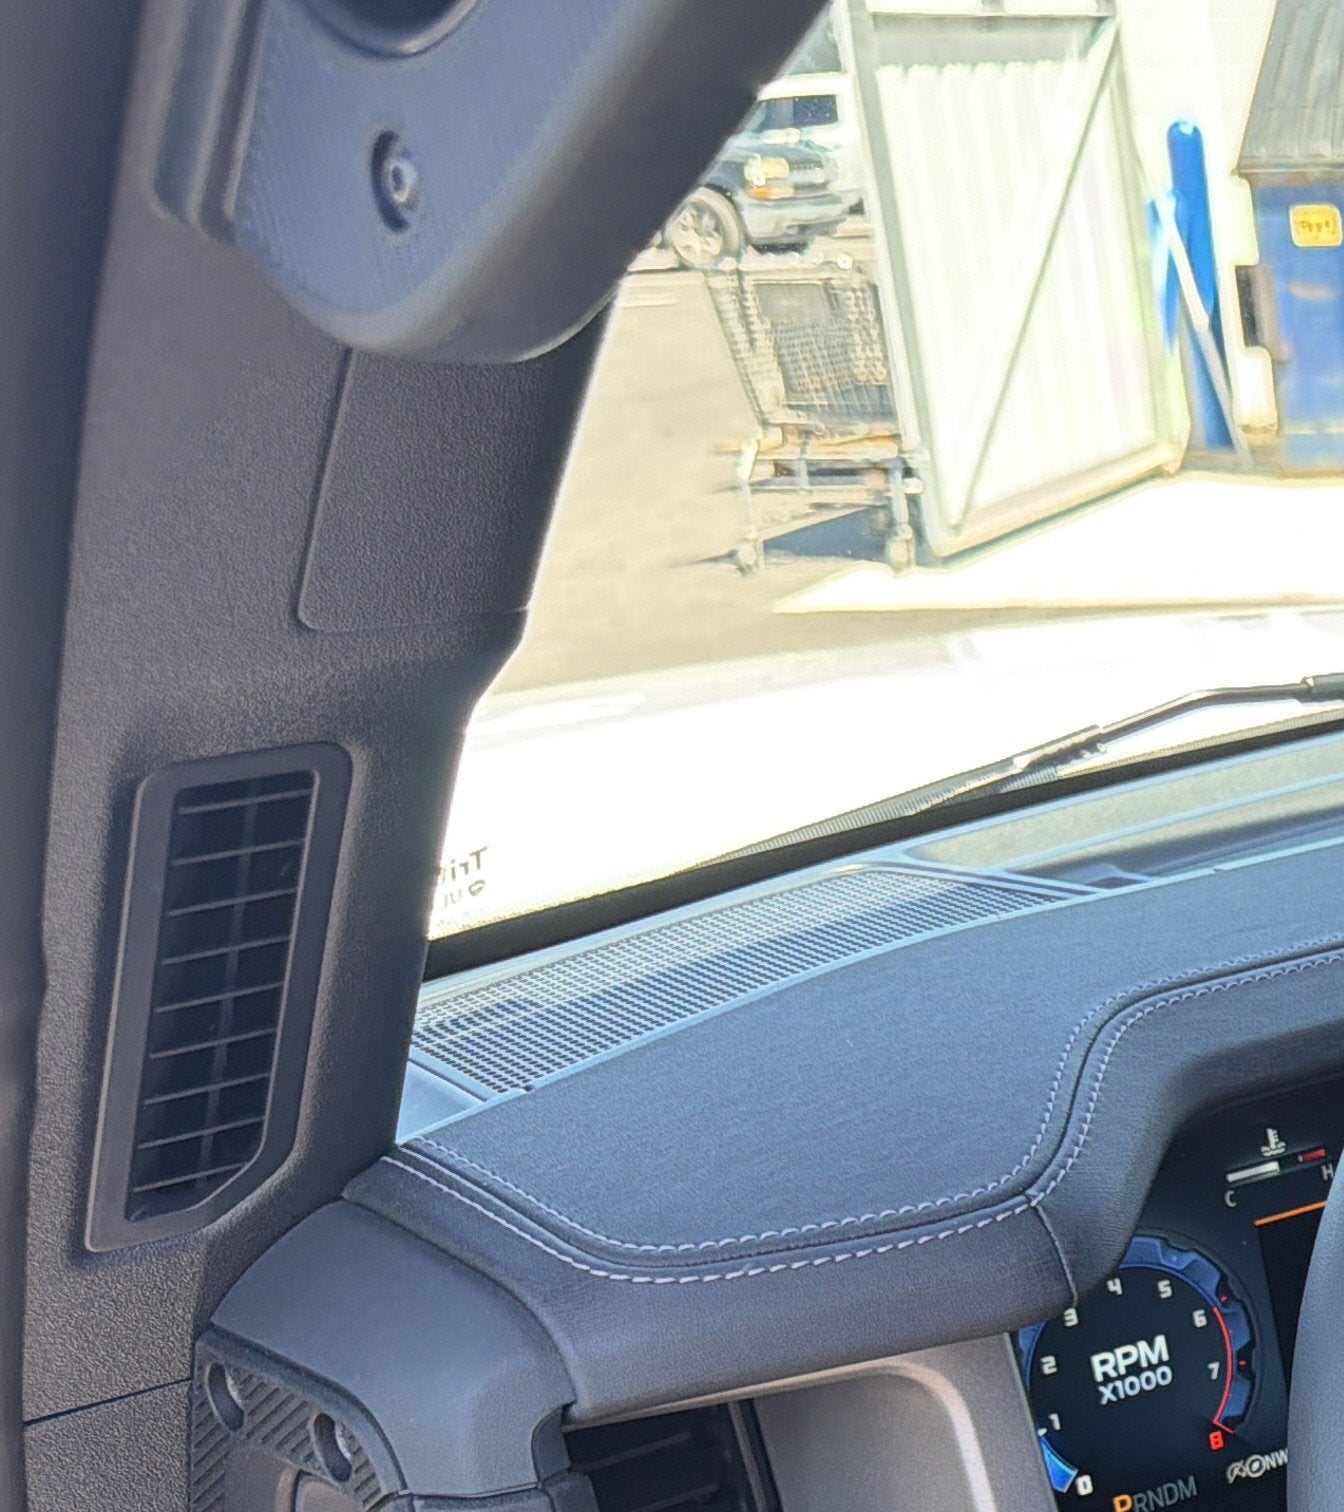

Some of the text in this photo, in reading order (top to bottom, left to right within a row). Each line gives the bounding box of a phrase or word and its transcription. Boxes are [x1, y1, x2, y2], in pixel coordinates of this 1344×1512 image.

[1321, 1163, 1334, 1181] H
[1224, 1190, 1237, 1208] C
[1106, 1277, 1123, 1297] 4
[1157, 1279, 1173, 1299] 5
[1063, 1307, 1079, 1327] 3
[1192, 1309, 1208, 1328] 6
[1040, 1355, 1058, 1375] 2
[1090, 1334, 1170, 1383] RPM
[1207, 1361, 1221, 1380] 7
[1099, 1365, 1174, 1405] X1000
[1049, 1413, 1062, 1431] 1
[1209, 1431, 1224, 1450] 8
[1075, 1474, 1093, 1496] 0
